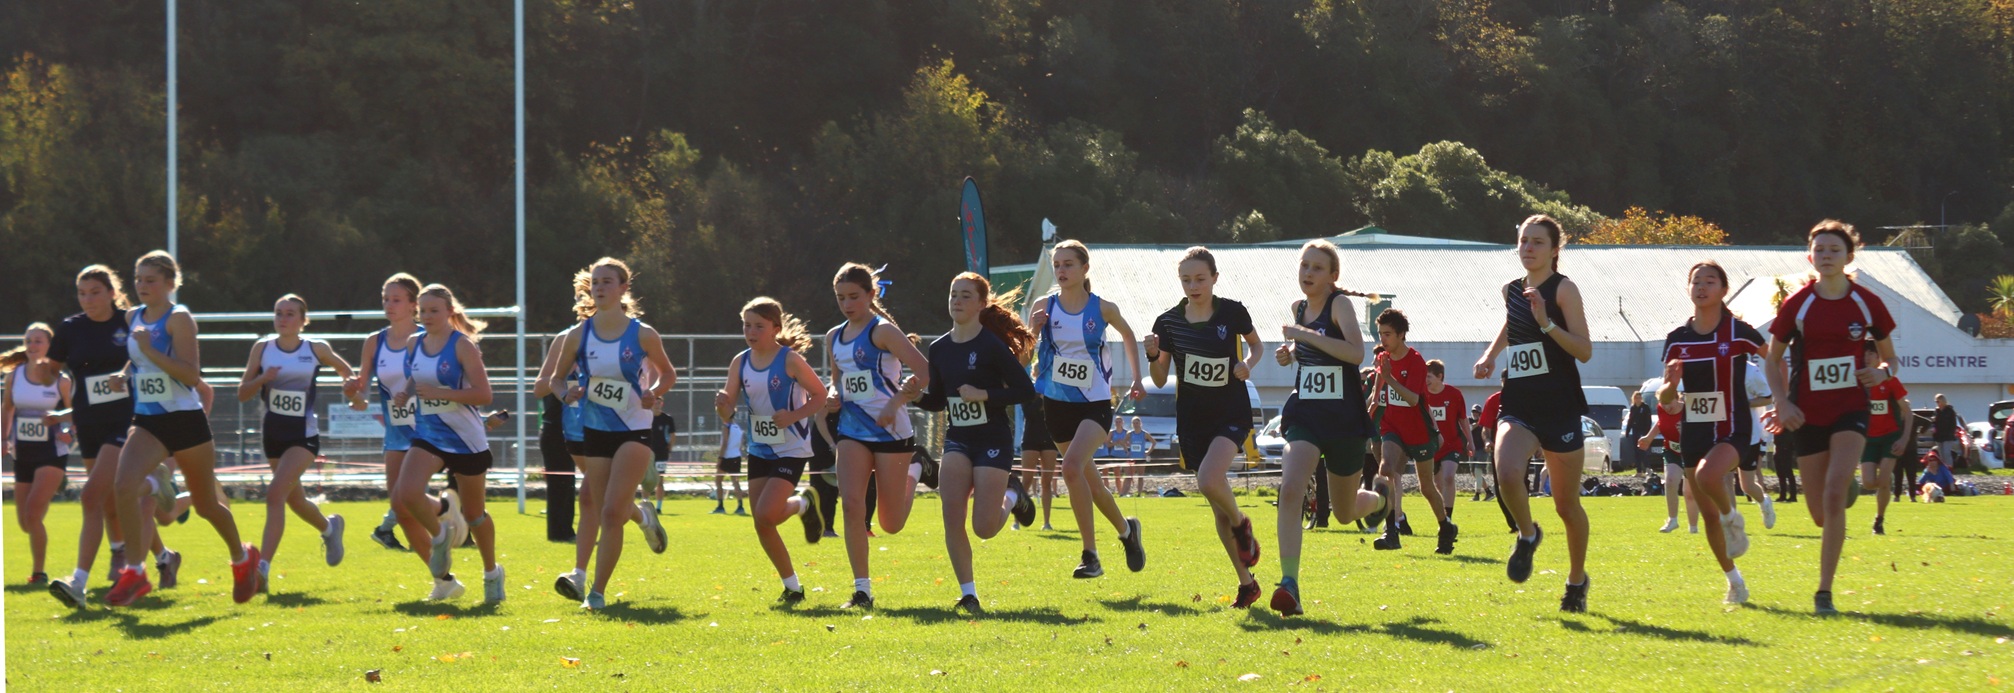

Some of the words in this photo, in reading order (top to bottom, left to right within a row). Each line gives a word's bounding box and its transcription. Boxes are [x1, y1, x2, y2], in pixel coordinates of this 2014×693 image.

[1511, 349, 1542, 371] 490
[1898, 356, 1920, 367] NIS
[1925, 355, 1987, 367] CENTRE
[1058, 362, 1087, 380] 458
[1189, 361, 1225, 381] 492
[1814, 362, 1851, 384] 497
[140, 378, 165, 395] 463
[845, 376, 868, 393] 456
[1303, 372, 1335, 393] 491
[593, 382, 624, 402] 454
[1390, 389, 1406, 401] 50
[272, 394, 302, 412] 486
[391, 402, 416, 419] 564
[952, 401, 982, 421] 489
[1691, 397, 1718, 414] 487
[1870, 403, 1884, 411] 03
[1432, 409, 1443, 418] 04
[19, 422, 45, 437] 480
[754, 421, 778, 436] 465
